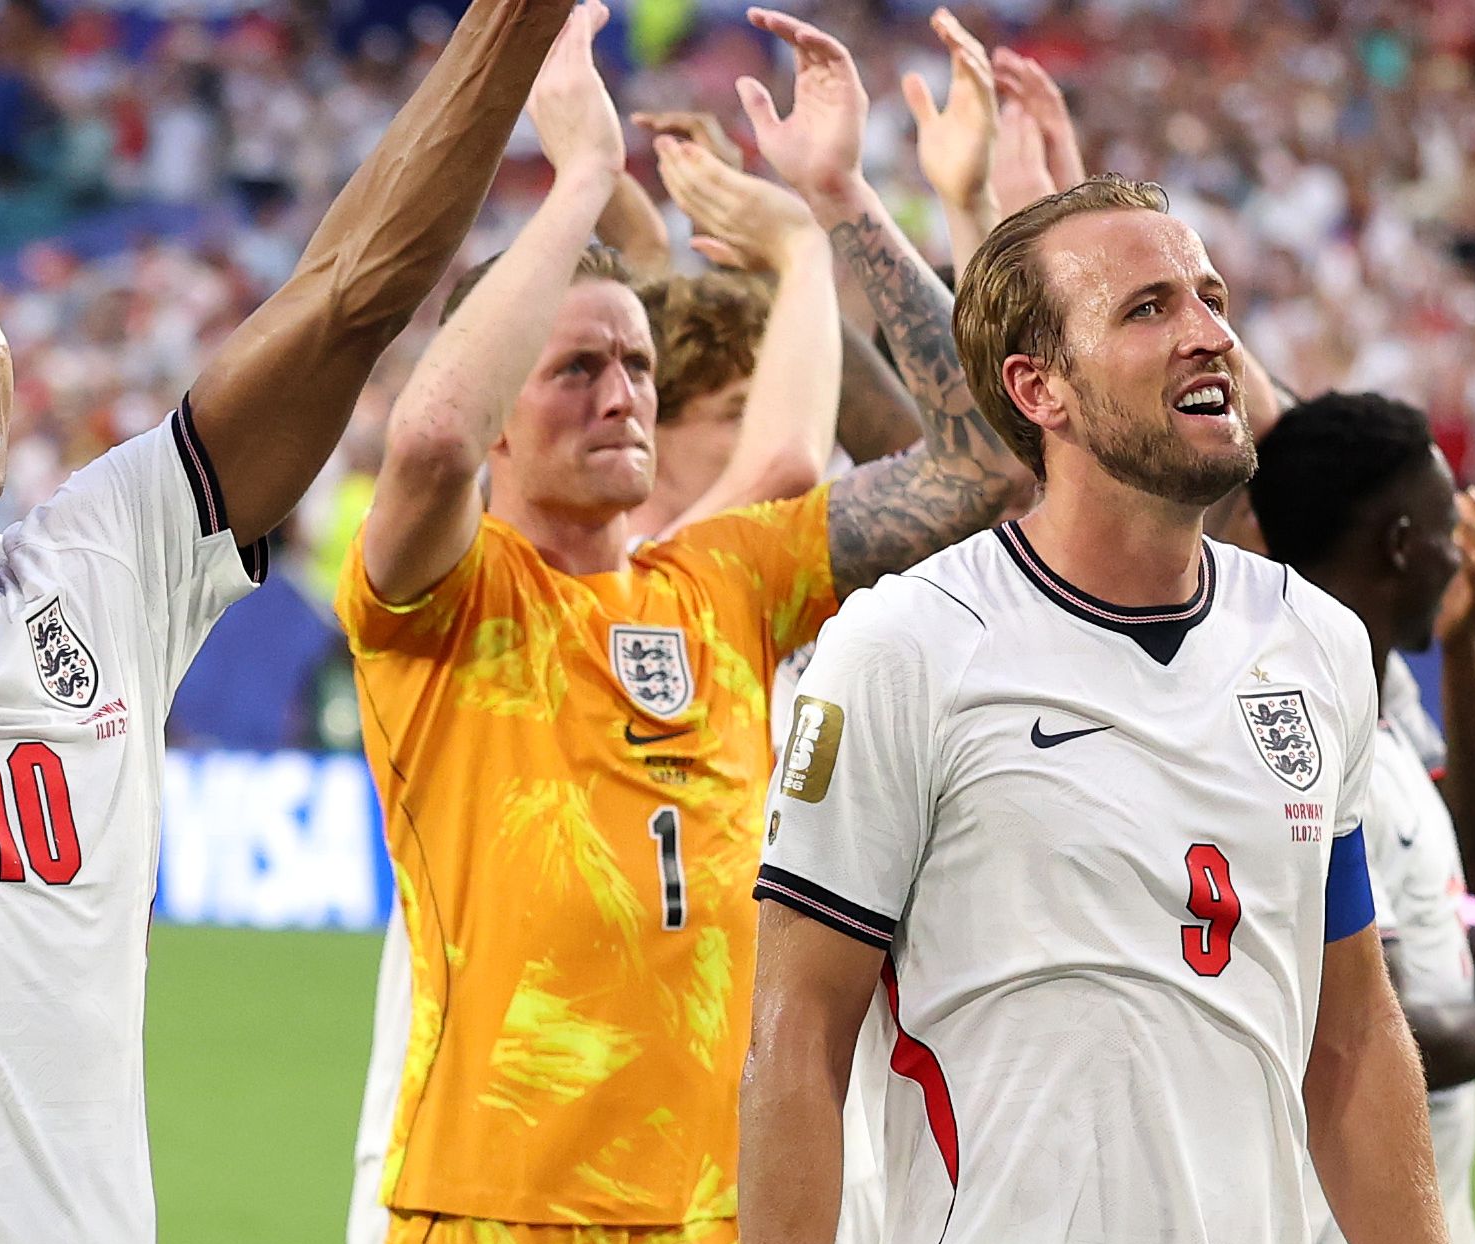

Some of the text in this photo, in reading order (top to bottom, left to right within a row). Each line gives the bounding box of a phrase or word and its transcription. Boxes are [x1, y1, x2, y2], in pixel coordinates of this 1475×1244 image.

[95, 716, 128, 741] 11.07.2
[1285, 803, 1324, 820] NORWAY
[647, 804, 689, 933] 1
[1180, 842, 1242, 978] 9
